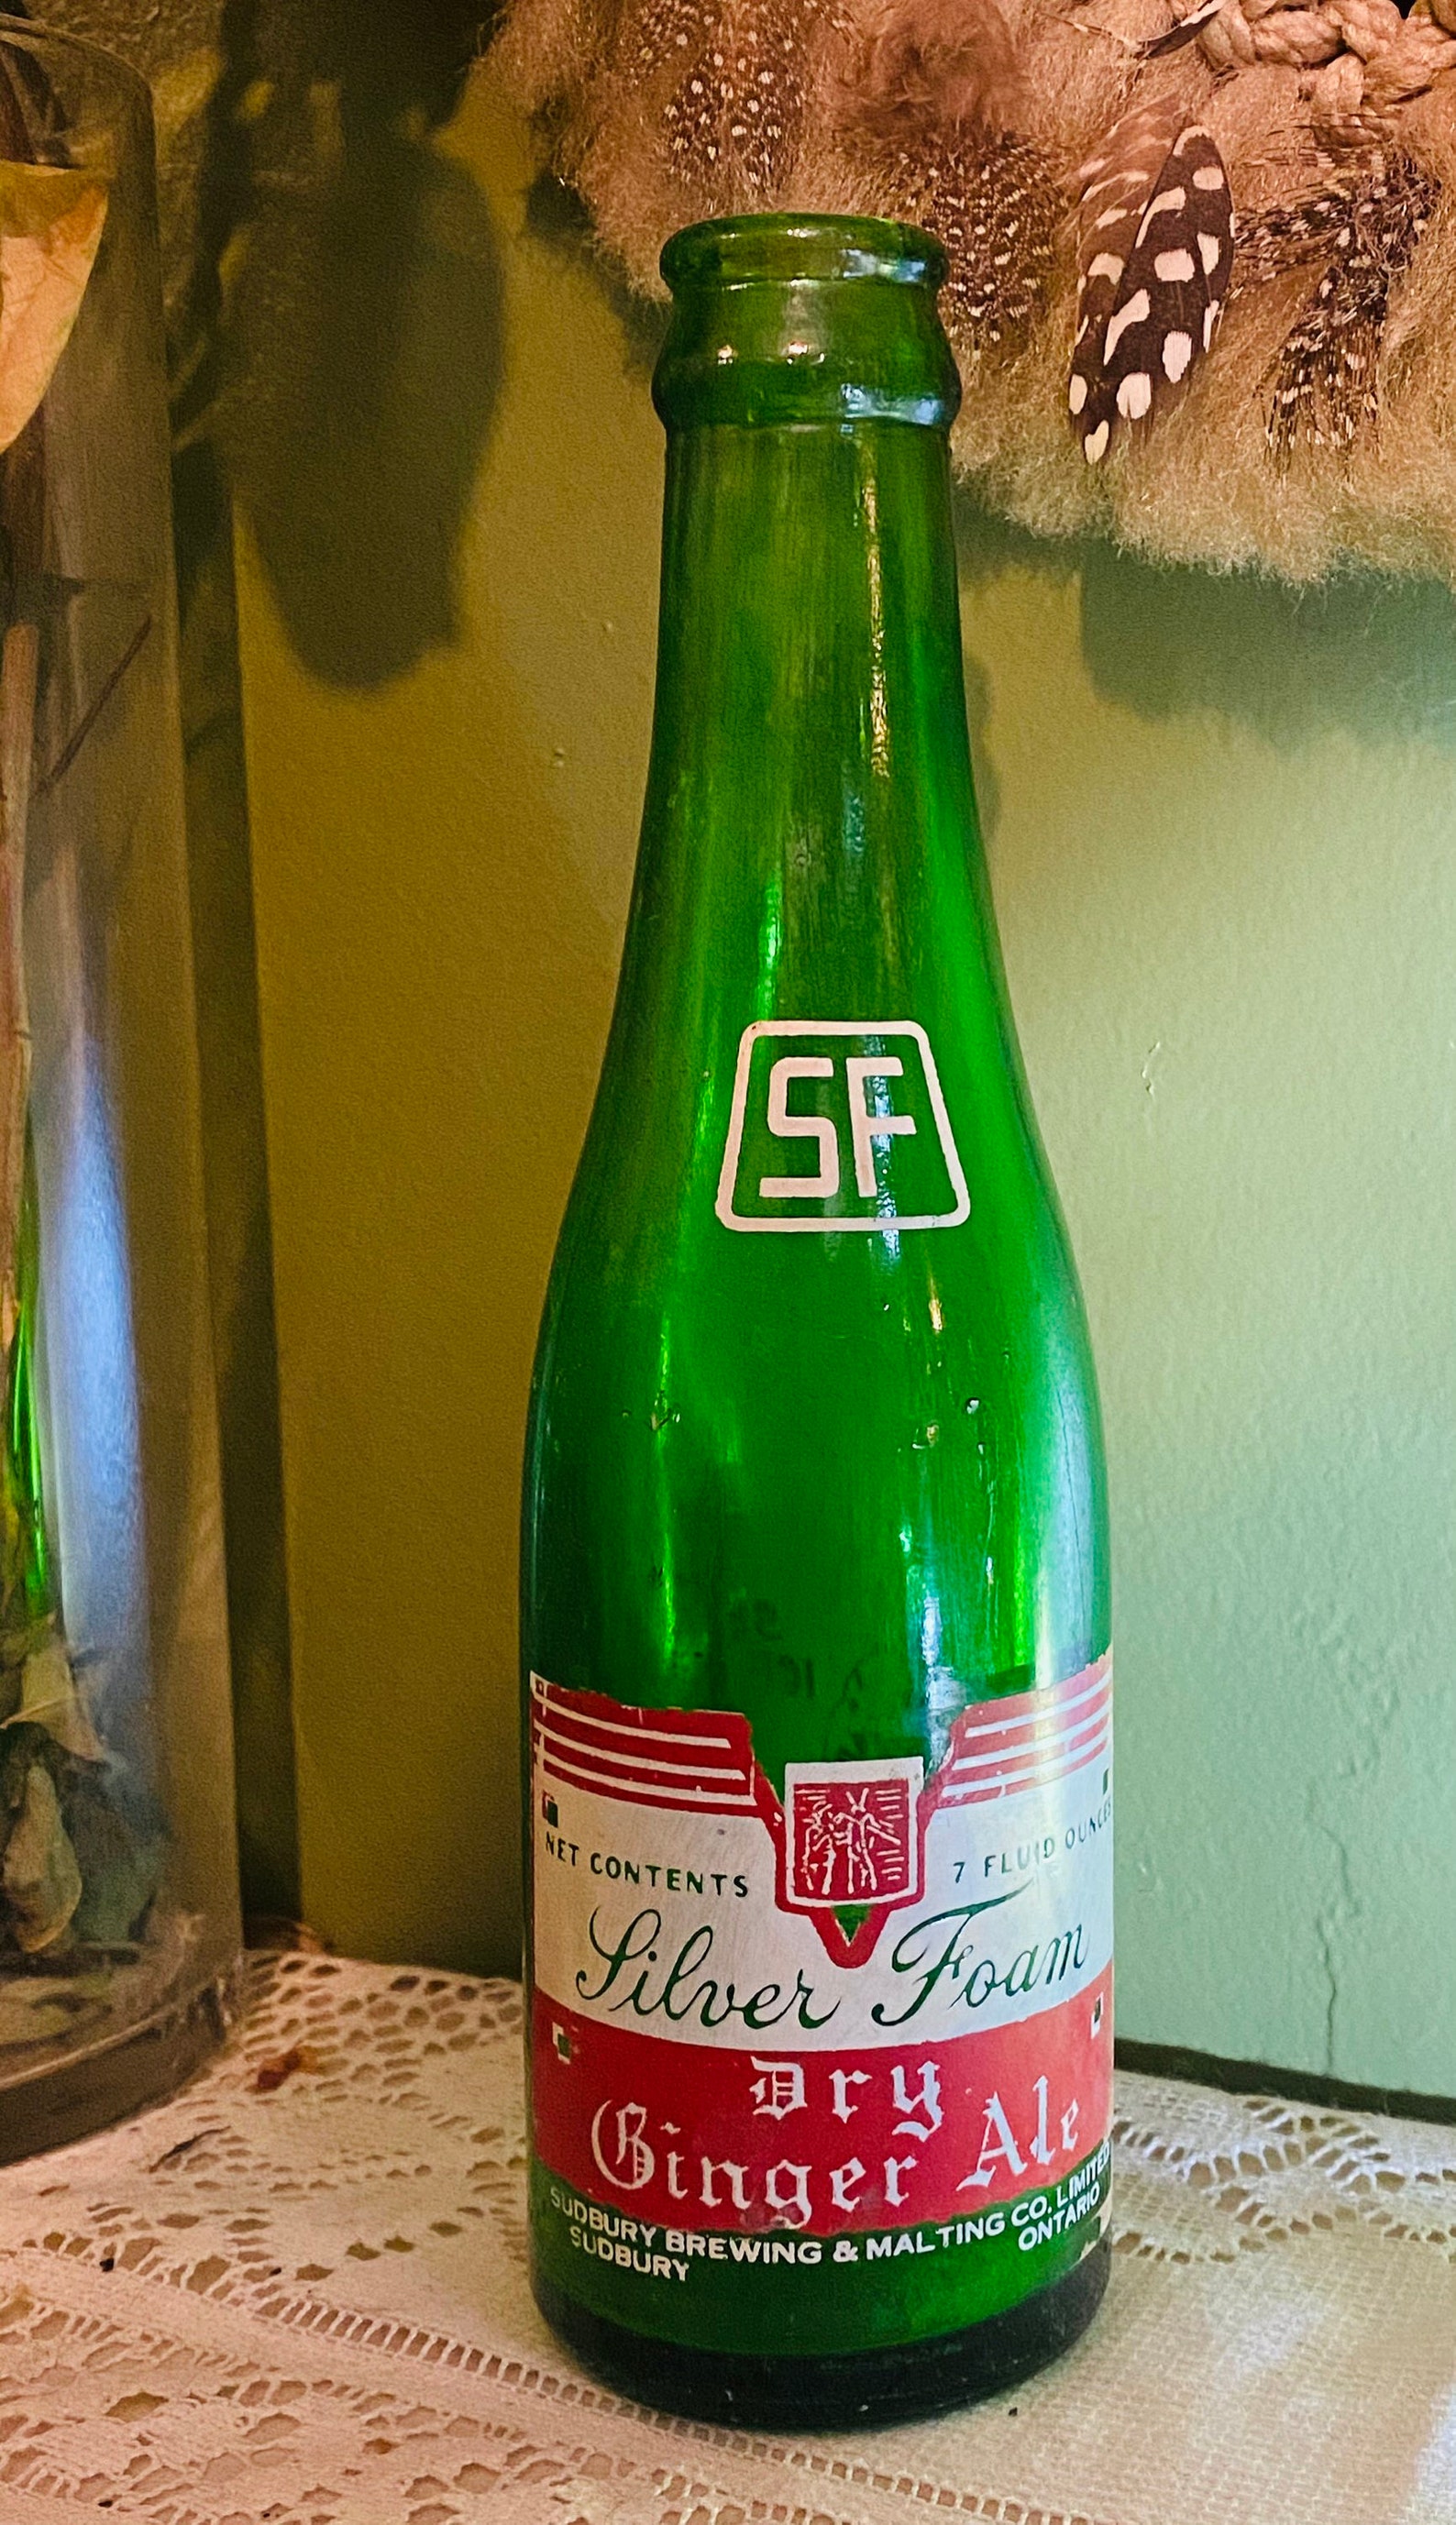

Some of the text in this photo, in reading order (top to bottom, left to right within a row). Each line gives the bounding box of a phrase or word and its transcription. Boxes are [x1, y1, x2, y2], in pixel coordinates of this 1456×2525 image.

[759, 1056, 917, 1197] SF
[546, 1832, 748, 1897] NET CONTENTS
[954, 1861, 965, 1883] 7
[984, 1837, 1055, 1877] FLUID
[575, 1877, 1087, 2029] Silver Foam
[590, 2075, 1080, 2228] Ginger Ale
[749, 2055, 943, 2141] Dry
[550, 2140, 1110, 2265] SUDBURY BREWING & MALTING CO. LIMITED
[569, 2181, 1100, 2281] SUDBURY ONTARIO
